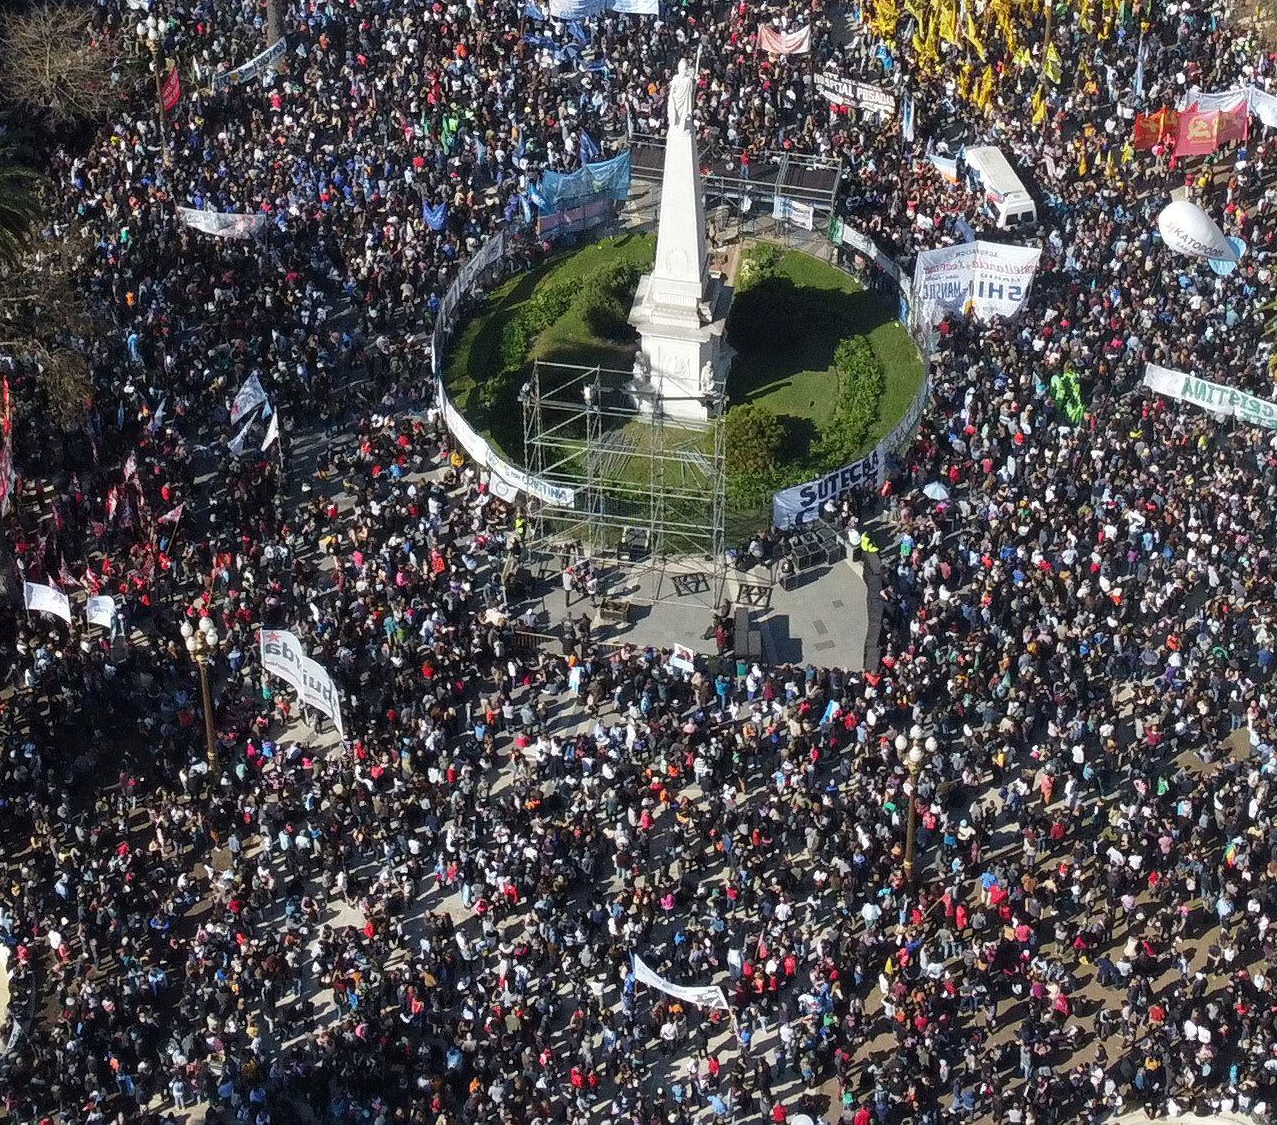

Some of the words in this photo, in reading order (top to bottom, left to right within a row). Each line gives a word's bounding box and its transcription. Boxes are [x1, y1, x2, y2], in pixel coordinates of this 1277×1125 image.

[814, 73, 854, 98] HOSPITAL
[856, 87, 895, 107] POSADAS
[800, 450, 879, 507] SUTECBA
